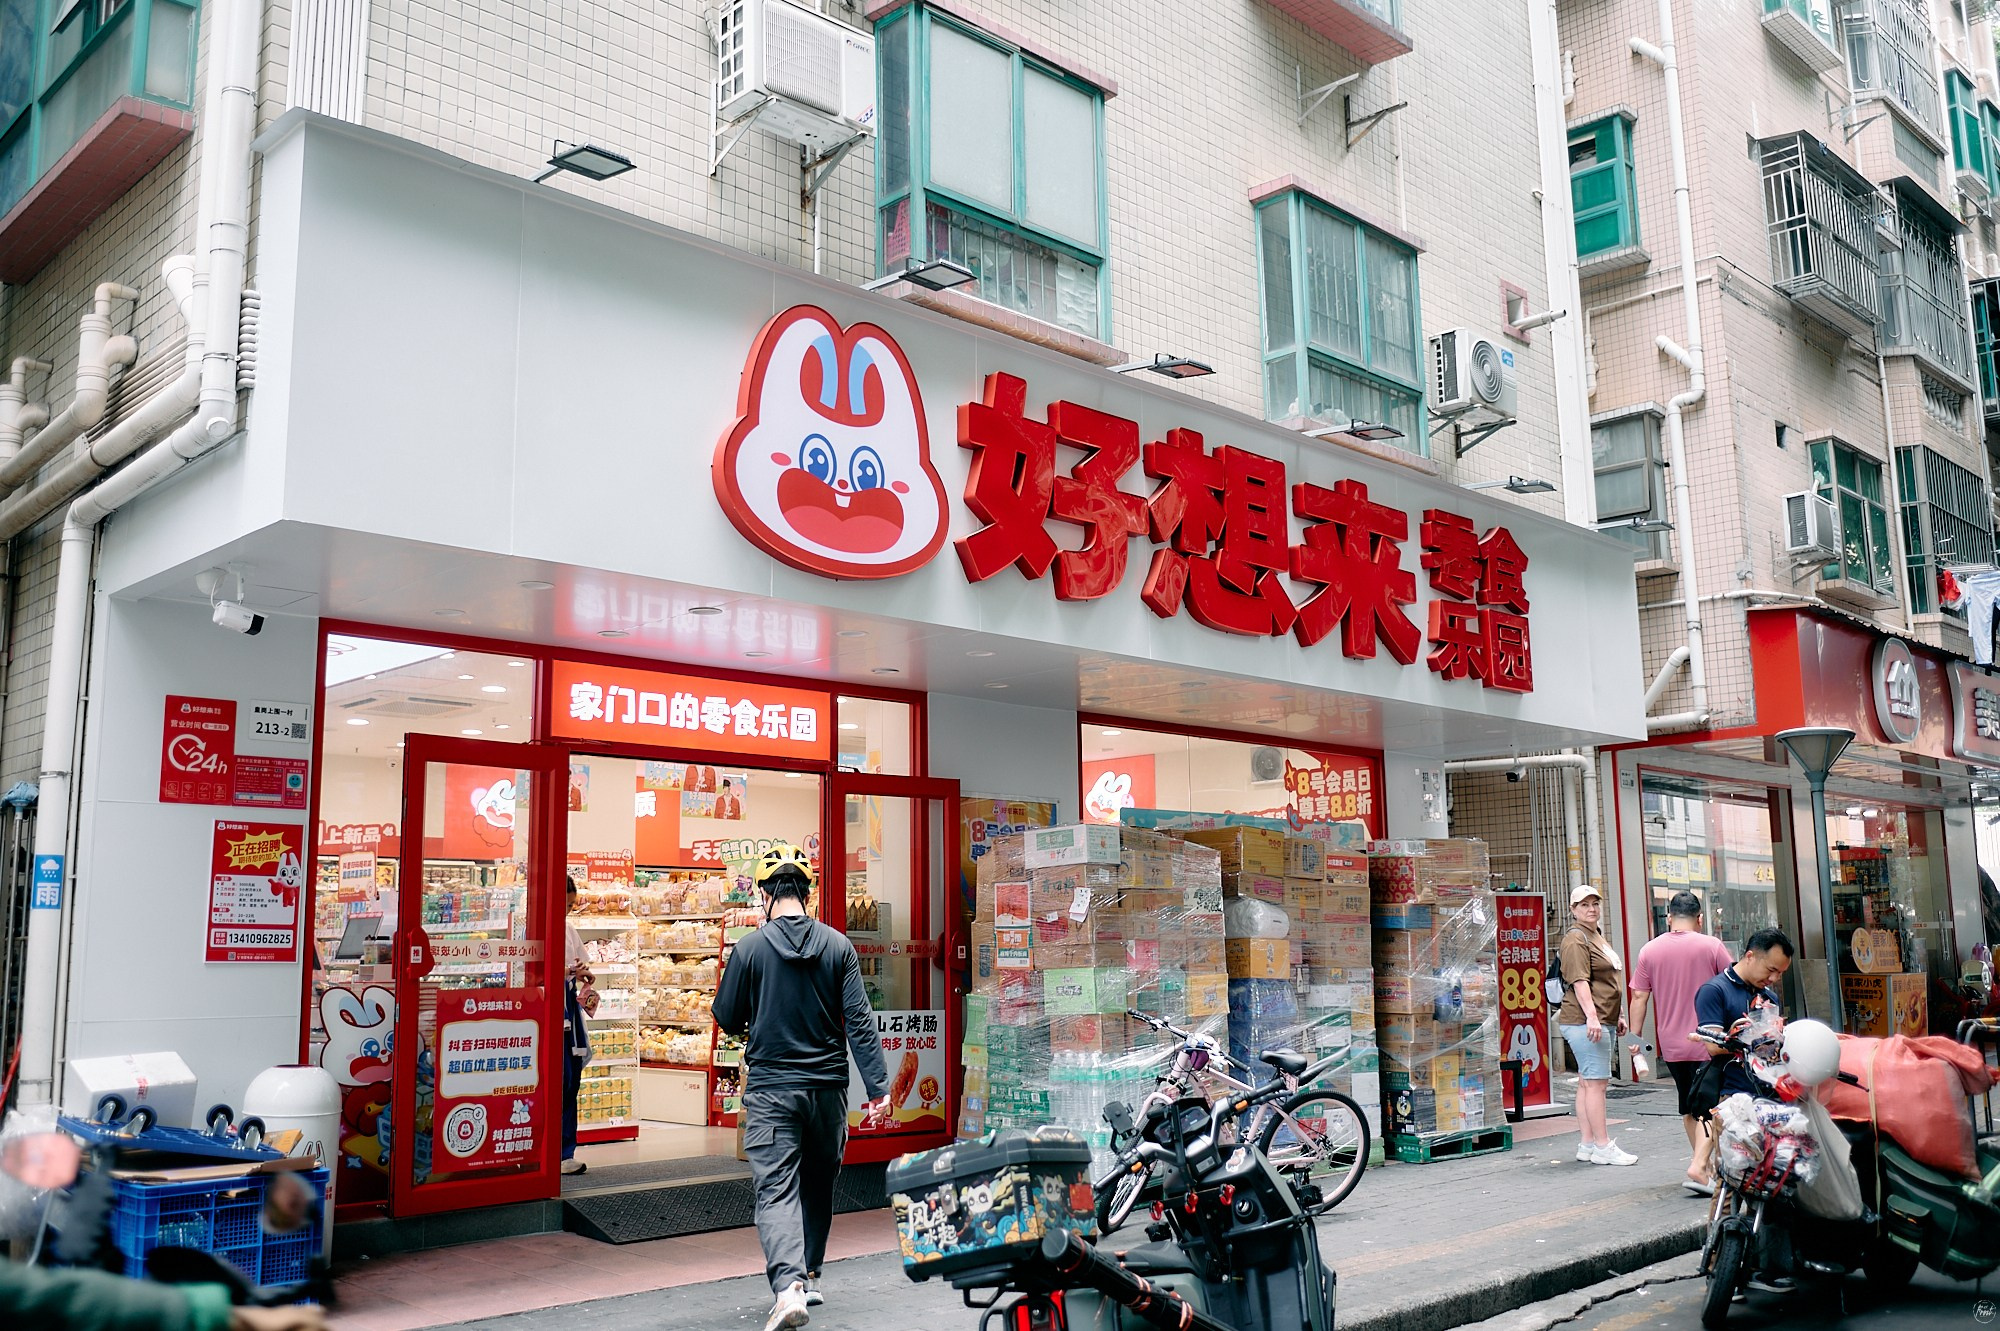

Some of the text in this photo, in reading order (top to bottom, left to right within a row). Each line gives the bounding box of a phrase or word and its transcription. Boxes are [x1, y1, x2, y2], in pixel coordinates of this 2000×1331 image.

[954, 370, 1419, 664] 好想来
[1422, 508, 1528, 613] 零食
[1427, 601, 1533, 694] 乐园
[570, 682, 818, 742] 家门口的零食乐园
[171, 720, 201, 730] 营业时间
[256, 721, 290, 737] 213-2
[186, 751, 228, 775] 24h
[1297, 768, 1371, 797] 8号会员日
[1298, 791, 1373, 820] 尊享8.8折
[318, 822, 381, 848] 上新品
[232, 839, 281, 857] 正在招聘
[238, 853, 278, 864] 期待您的加入
[36, 882, 61, 906] 雨
[229, 933, 291, 944] 13410962825
[1501, 946, 1540, 964] 会员独享
[1844, 977, 1883, 989] 皇家小虎
[478, 1001, 504, 1011] 好想来
[448, 1035, 532, 1052] 抖音扫码随机减
[881, 1036, 937, 1050] 肉多 放心吃
[448, 1056, 532, 1074] 超值优惠等你享
[492, 1126, 532, 1141] 抖音扫码
[494, 1139, 534, 1154] 立即领取
